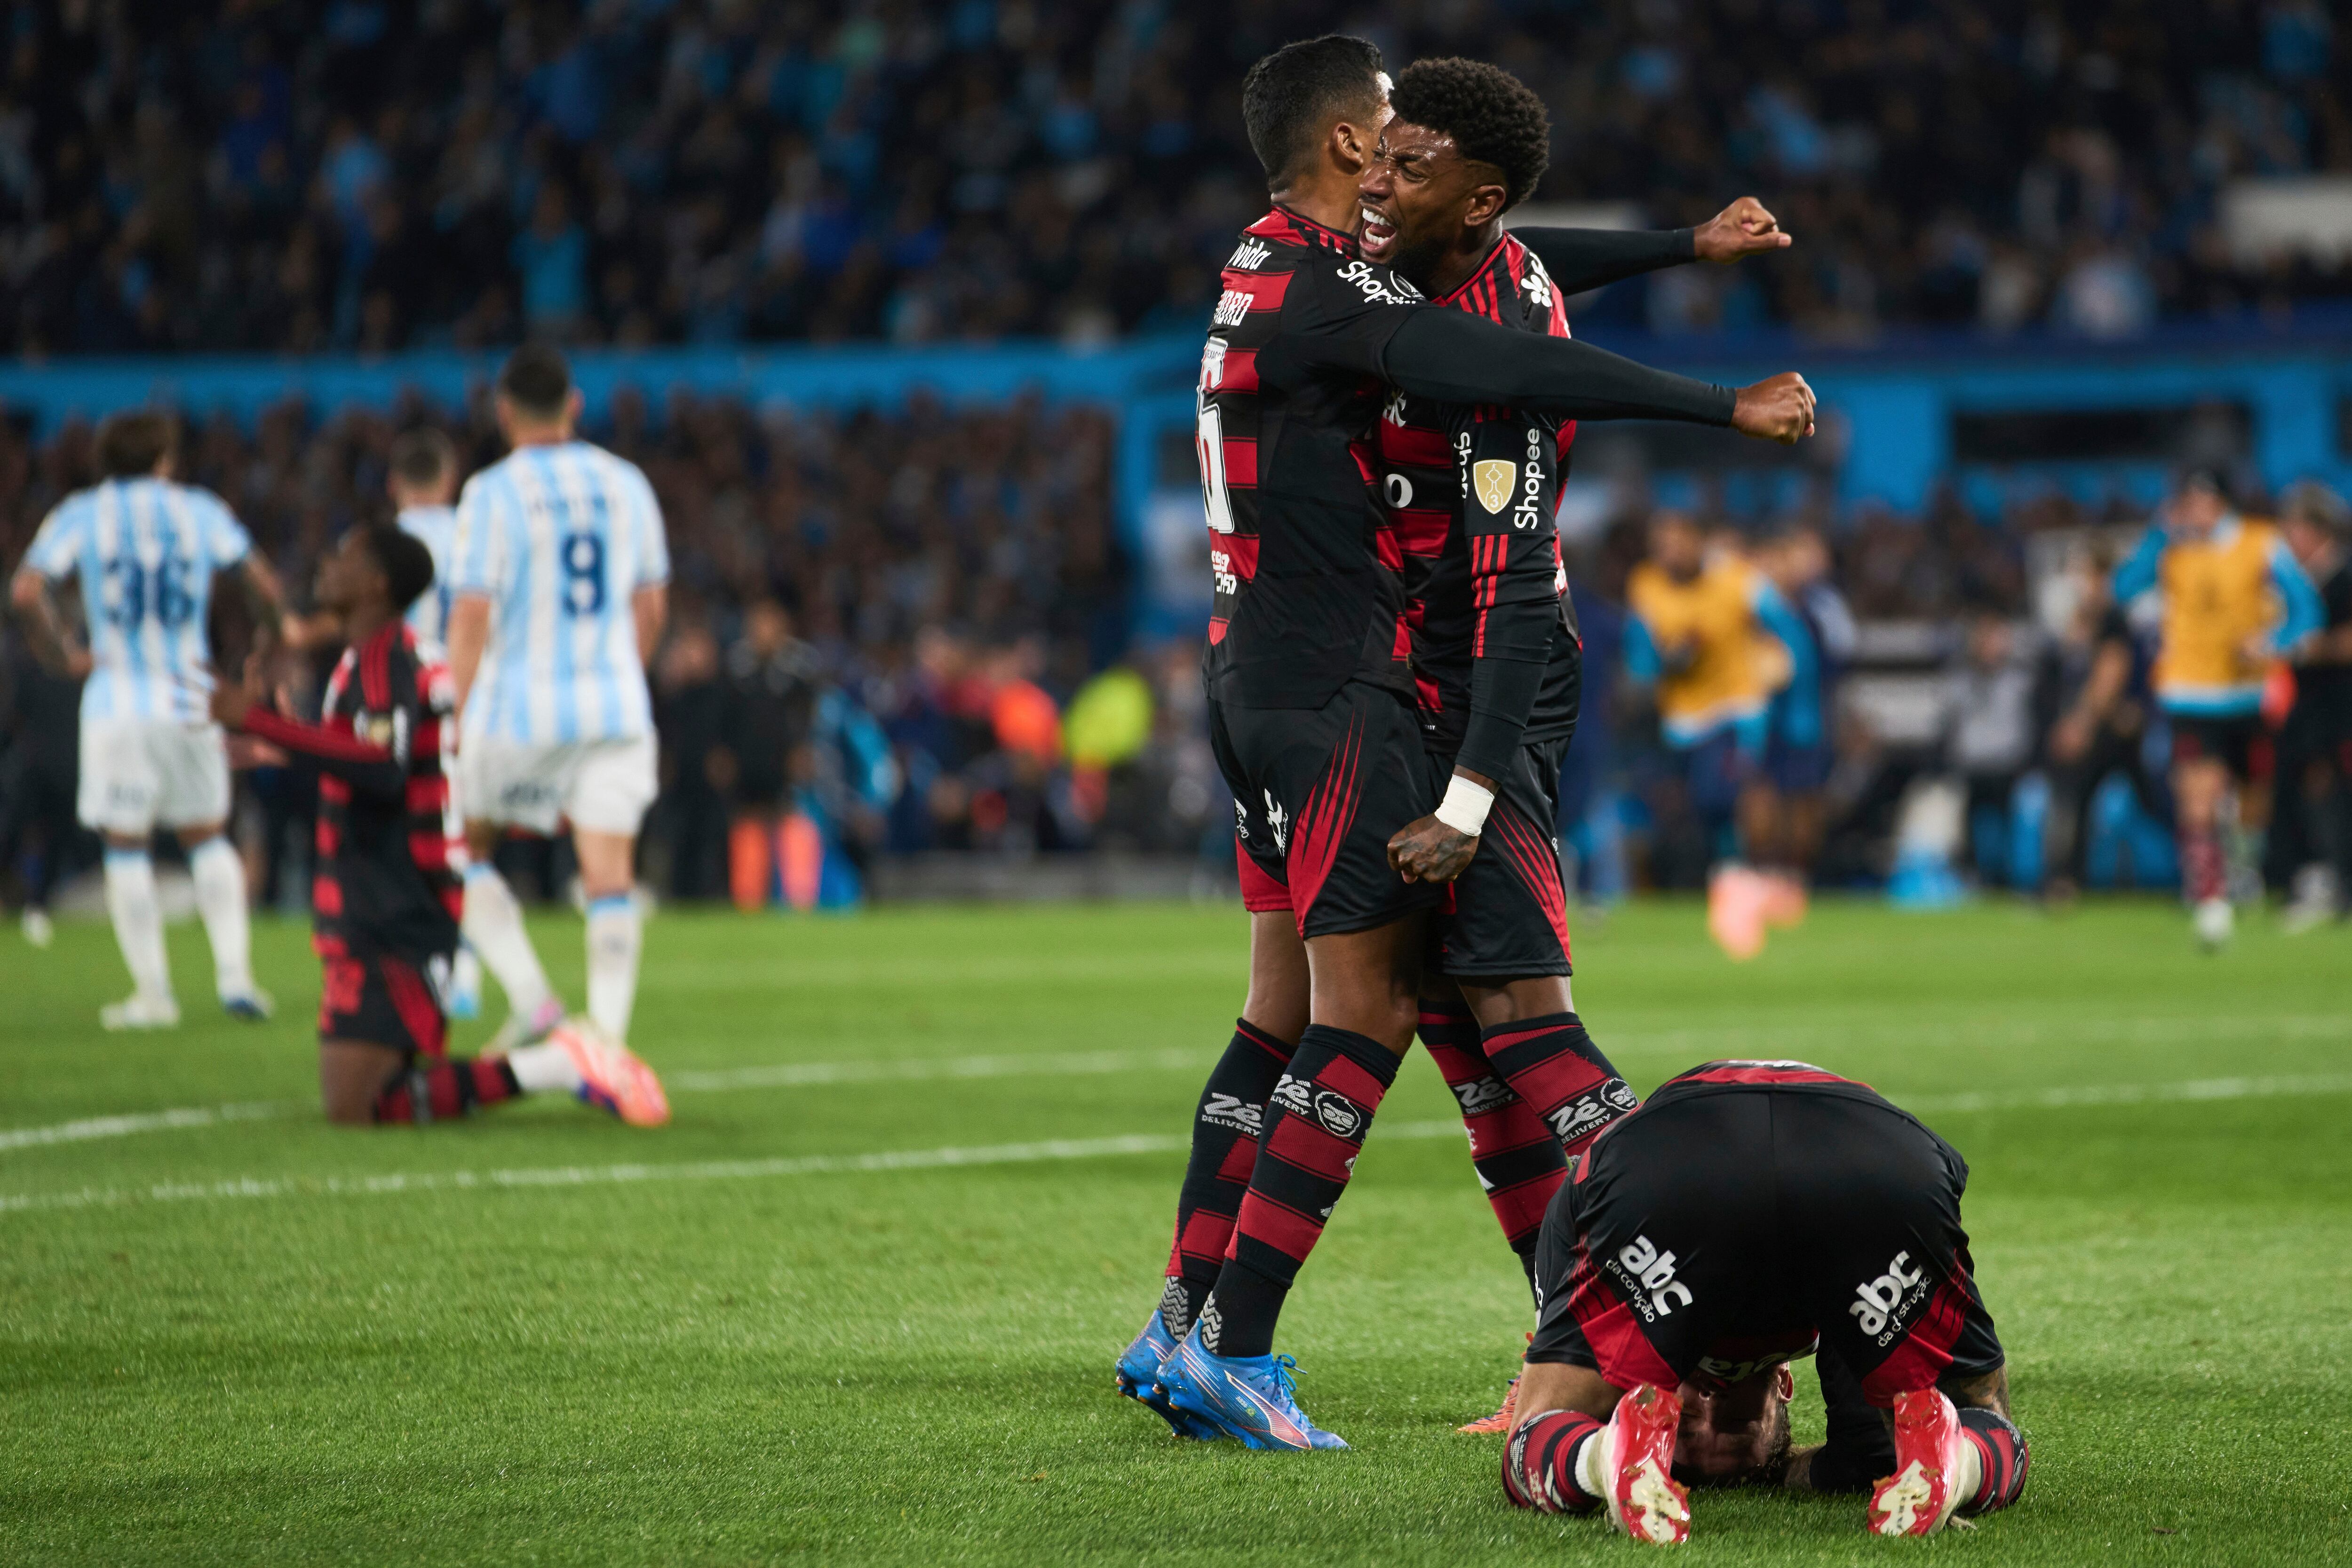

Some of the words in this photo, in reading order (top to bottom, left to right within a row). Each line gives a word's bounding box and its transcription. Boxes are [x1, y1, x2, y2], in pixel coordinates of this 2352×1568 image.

[1514, 428, 1545, 530] Shopee
[1490, 494, 1499, 508] 3
[561, 530, 606, 617] 9
[101, 556, 196, 631] 36
[1271, 1095, 1310, 1116] LIVERY
[1454, 1076, 1509, 1107] Zé
[1201, 1114, 1261, 1136] DELIVERY
[1204, 1092, 1263, 1128] Zé
[1548, 1095, 1607, 1137] Zé
[1561, 1113, 1611, 1144] DELIVERY
[1605, 1259, 1622, 1275] da
[1619, 1234, 1693, 1316] abc
[1849, 1249, 1924, 1336] abc
[1878, 1330, 1894, 1347] da
